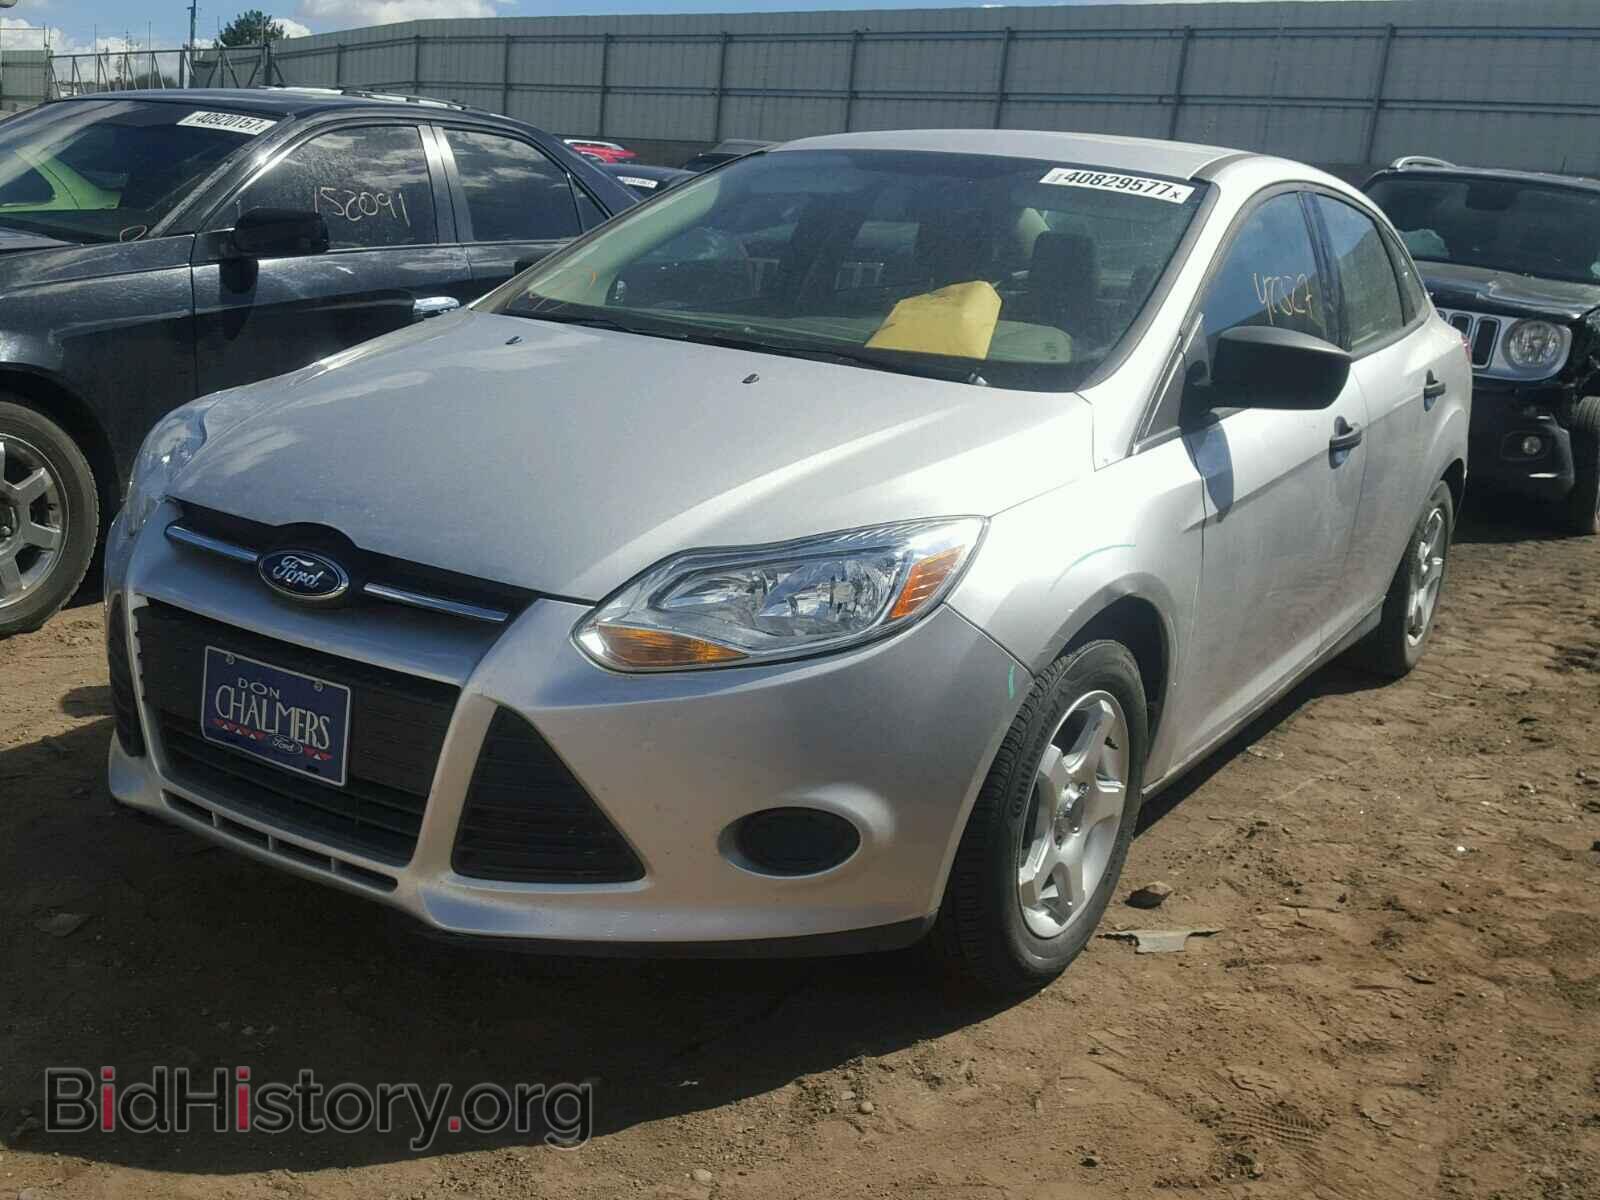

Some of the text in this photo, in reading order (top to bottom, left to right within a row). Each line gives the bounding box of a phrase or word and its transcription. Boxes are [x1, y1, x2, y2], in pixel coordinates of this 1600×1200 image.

[1063, 171, 1173, 196] 40829577
[273, 555, 325, 589] Ford
[238, 677, 281, 700] DON
[215, 684, 331, 751] CHALMERS
